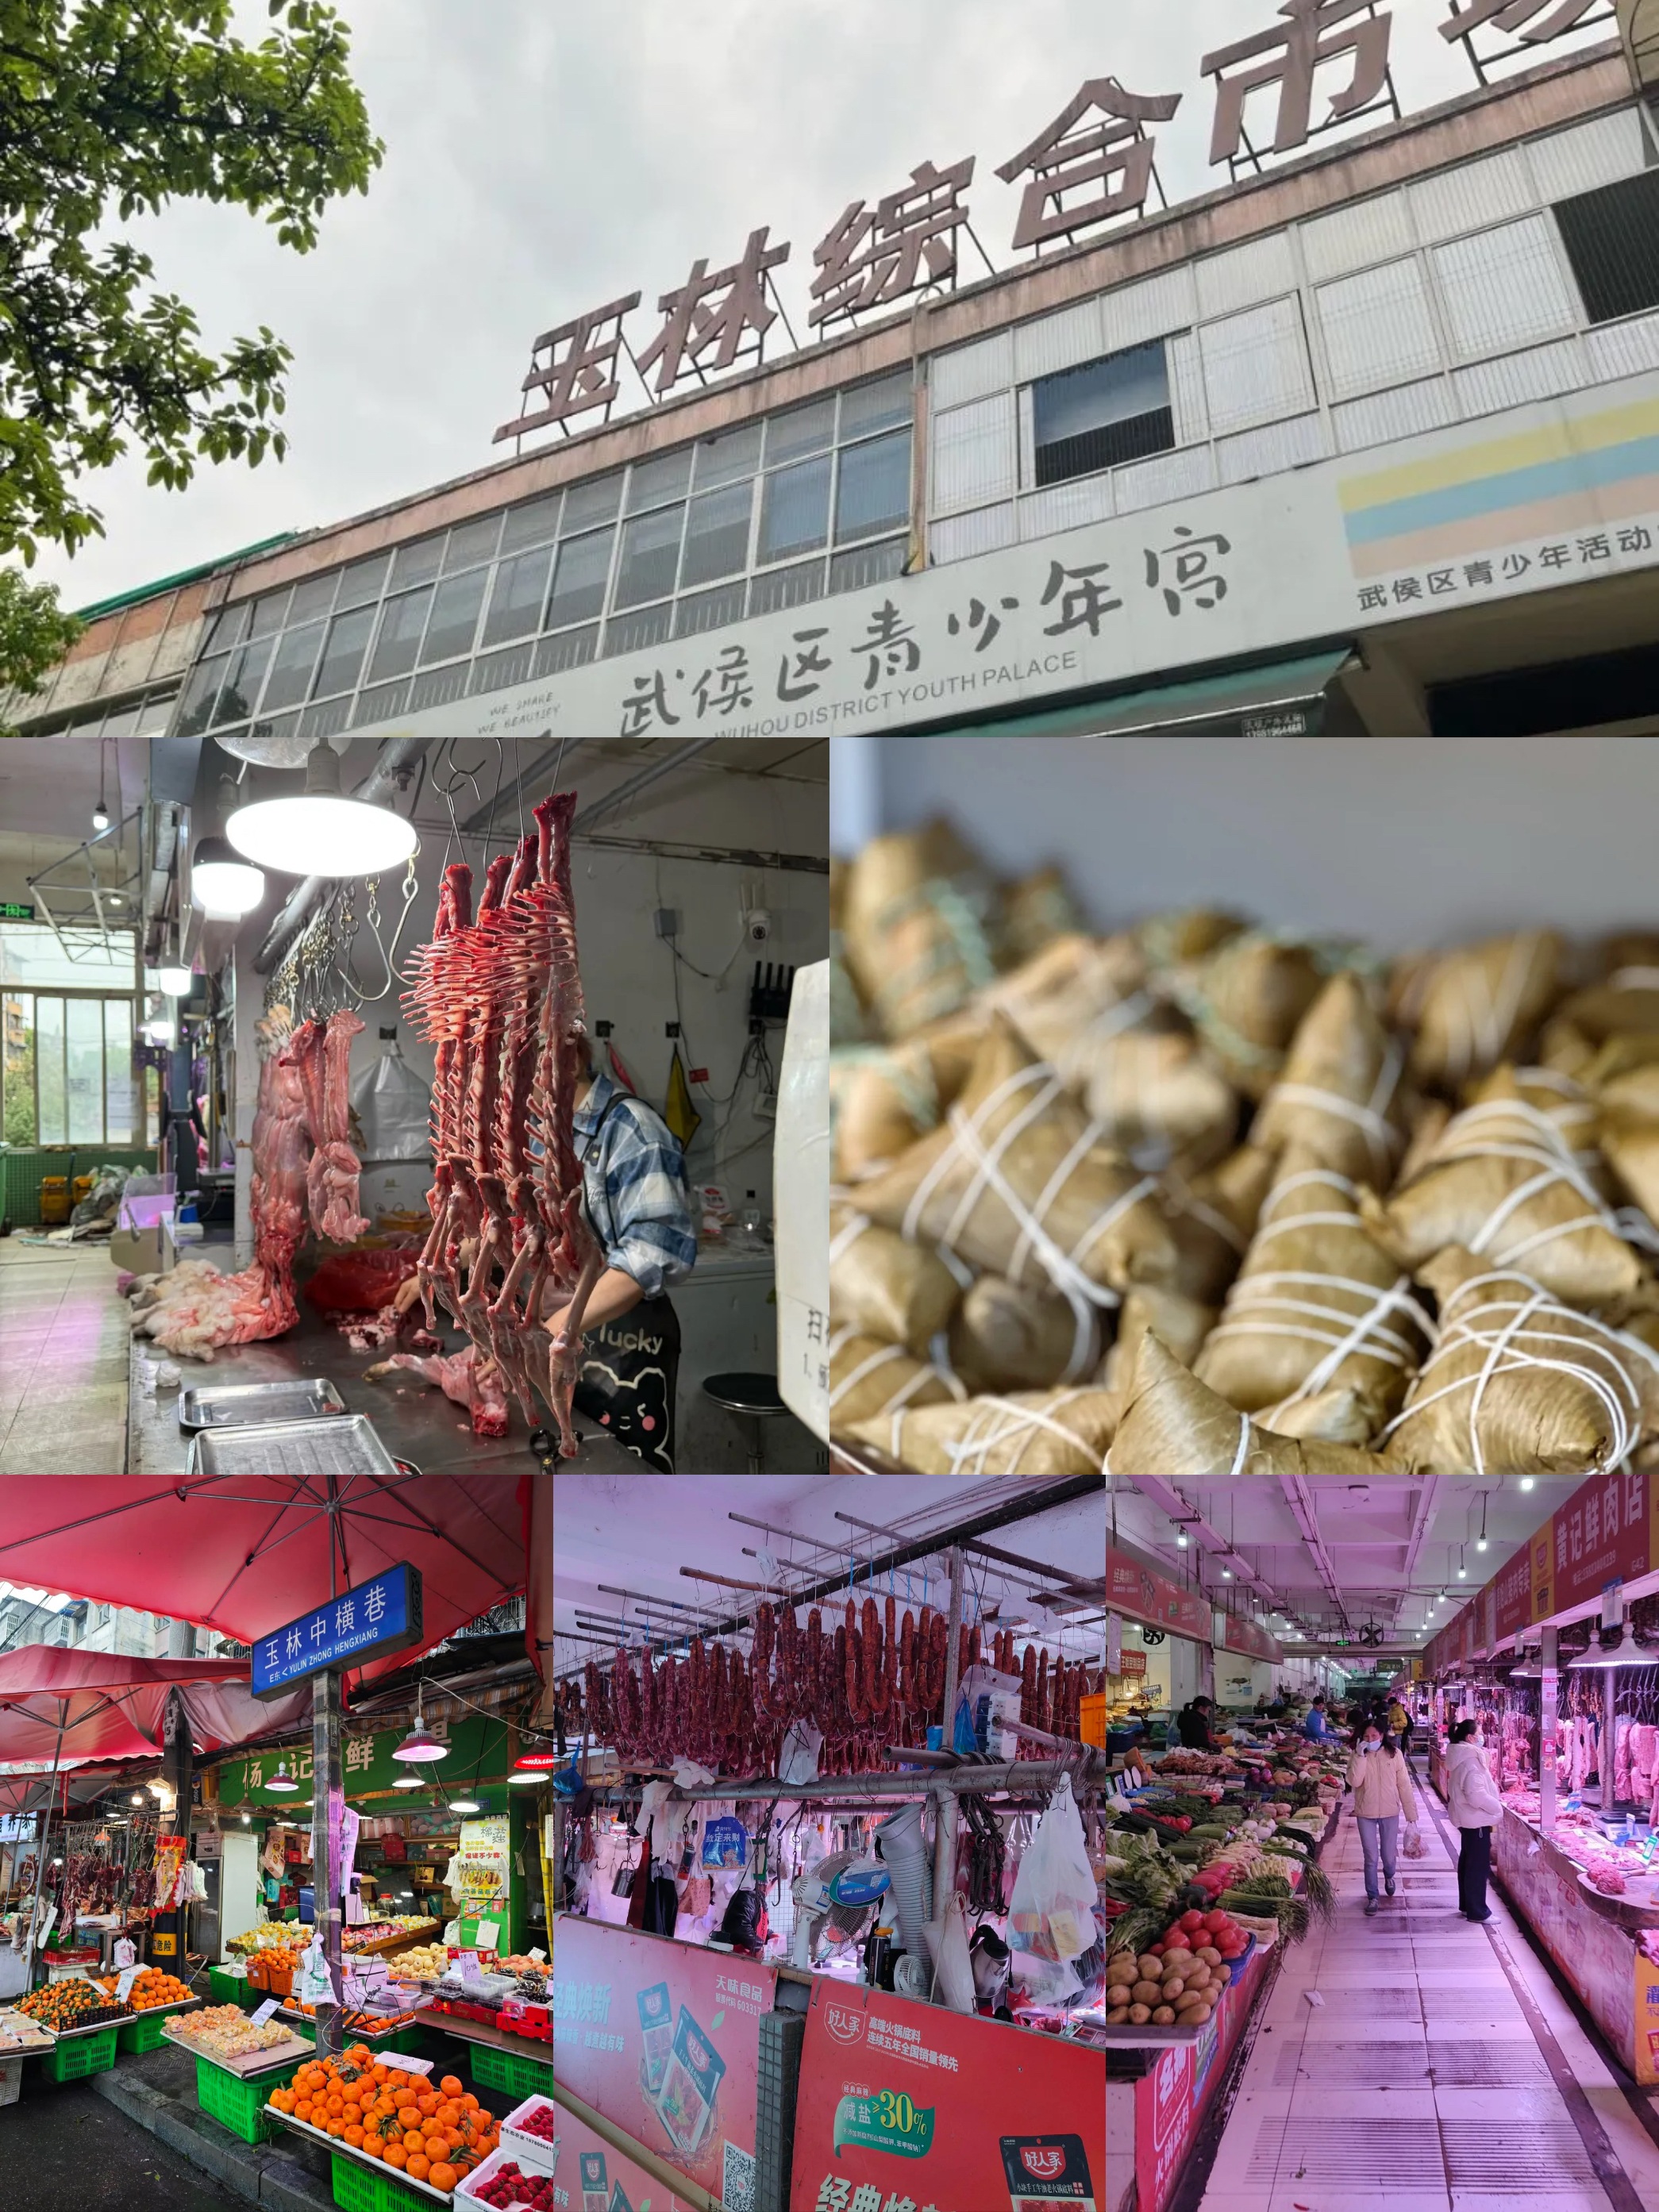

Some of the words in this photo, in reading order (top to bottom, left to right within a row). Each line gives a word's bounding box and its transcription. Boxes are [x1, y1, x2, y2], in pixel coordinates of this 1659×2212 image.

[1356, 525, 1659, 611] 武侯区青少年活动
[621, 525, 1231, 737] 武侯区青少年宫
[794, 691, 890, 729] DISTRICT
[897, 668, 977, 706] YOUTH
[983, 649, 1080, 689] PALACE
[599, 1321, 663, 1356] lucky
[807, 1308, 830, 1348] 扫
[1557, 1475, 1643, 1574] 黄记鲜肉店
[264, 1584, 387, 1670] 玉林中横巷
[289, 1661, 307, 1673] YULIN
[309, 1647, 332, 1665] ZHONG
[334, 1626, 379, 1655] HENGXIANG
[715, 1992, 736, 2010] 股票代码
[737, 1998, 762, 2018] 603317
[716, 1974, 763, 2003] 天味食品
[827, 2008, 860, 2033] 好人家
[868, 2016, 921, 2045] 高端火锅底料
[867, 2030, 959, 2072] 连续五年全国销量领先
[843, 2083, 869, 2097] 经典麻辣
[843, 2101, 872, 2125] 减盐
[1024, 2151, 1063, 2168] 好人家
